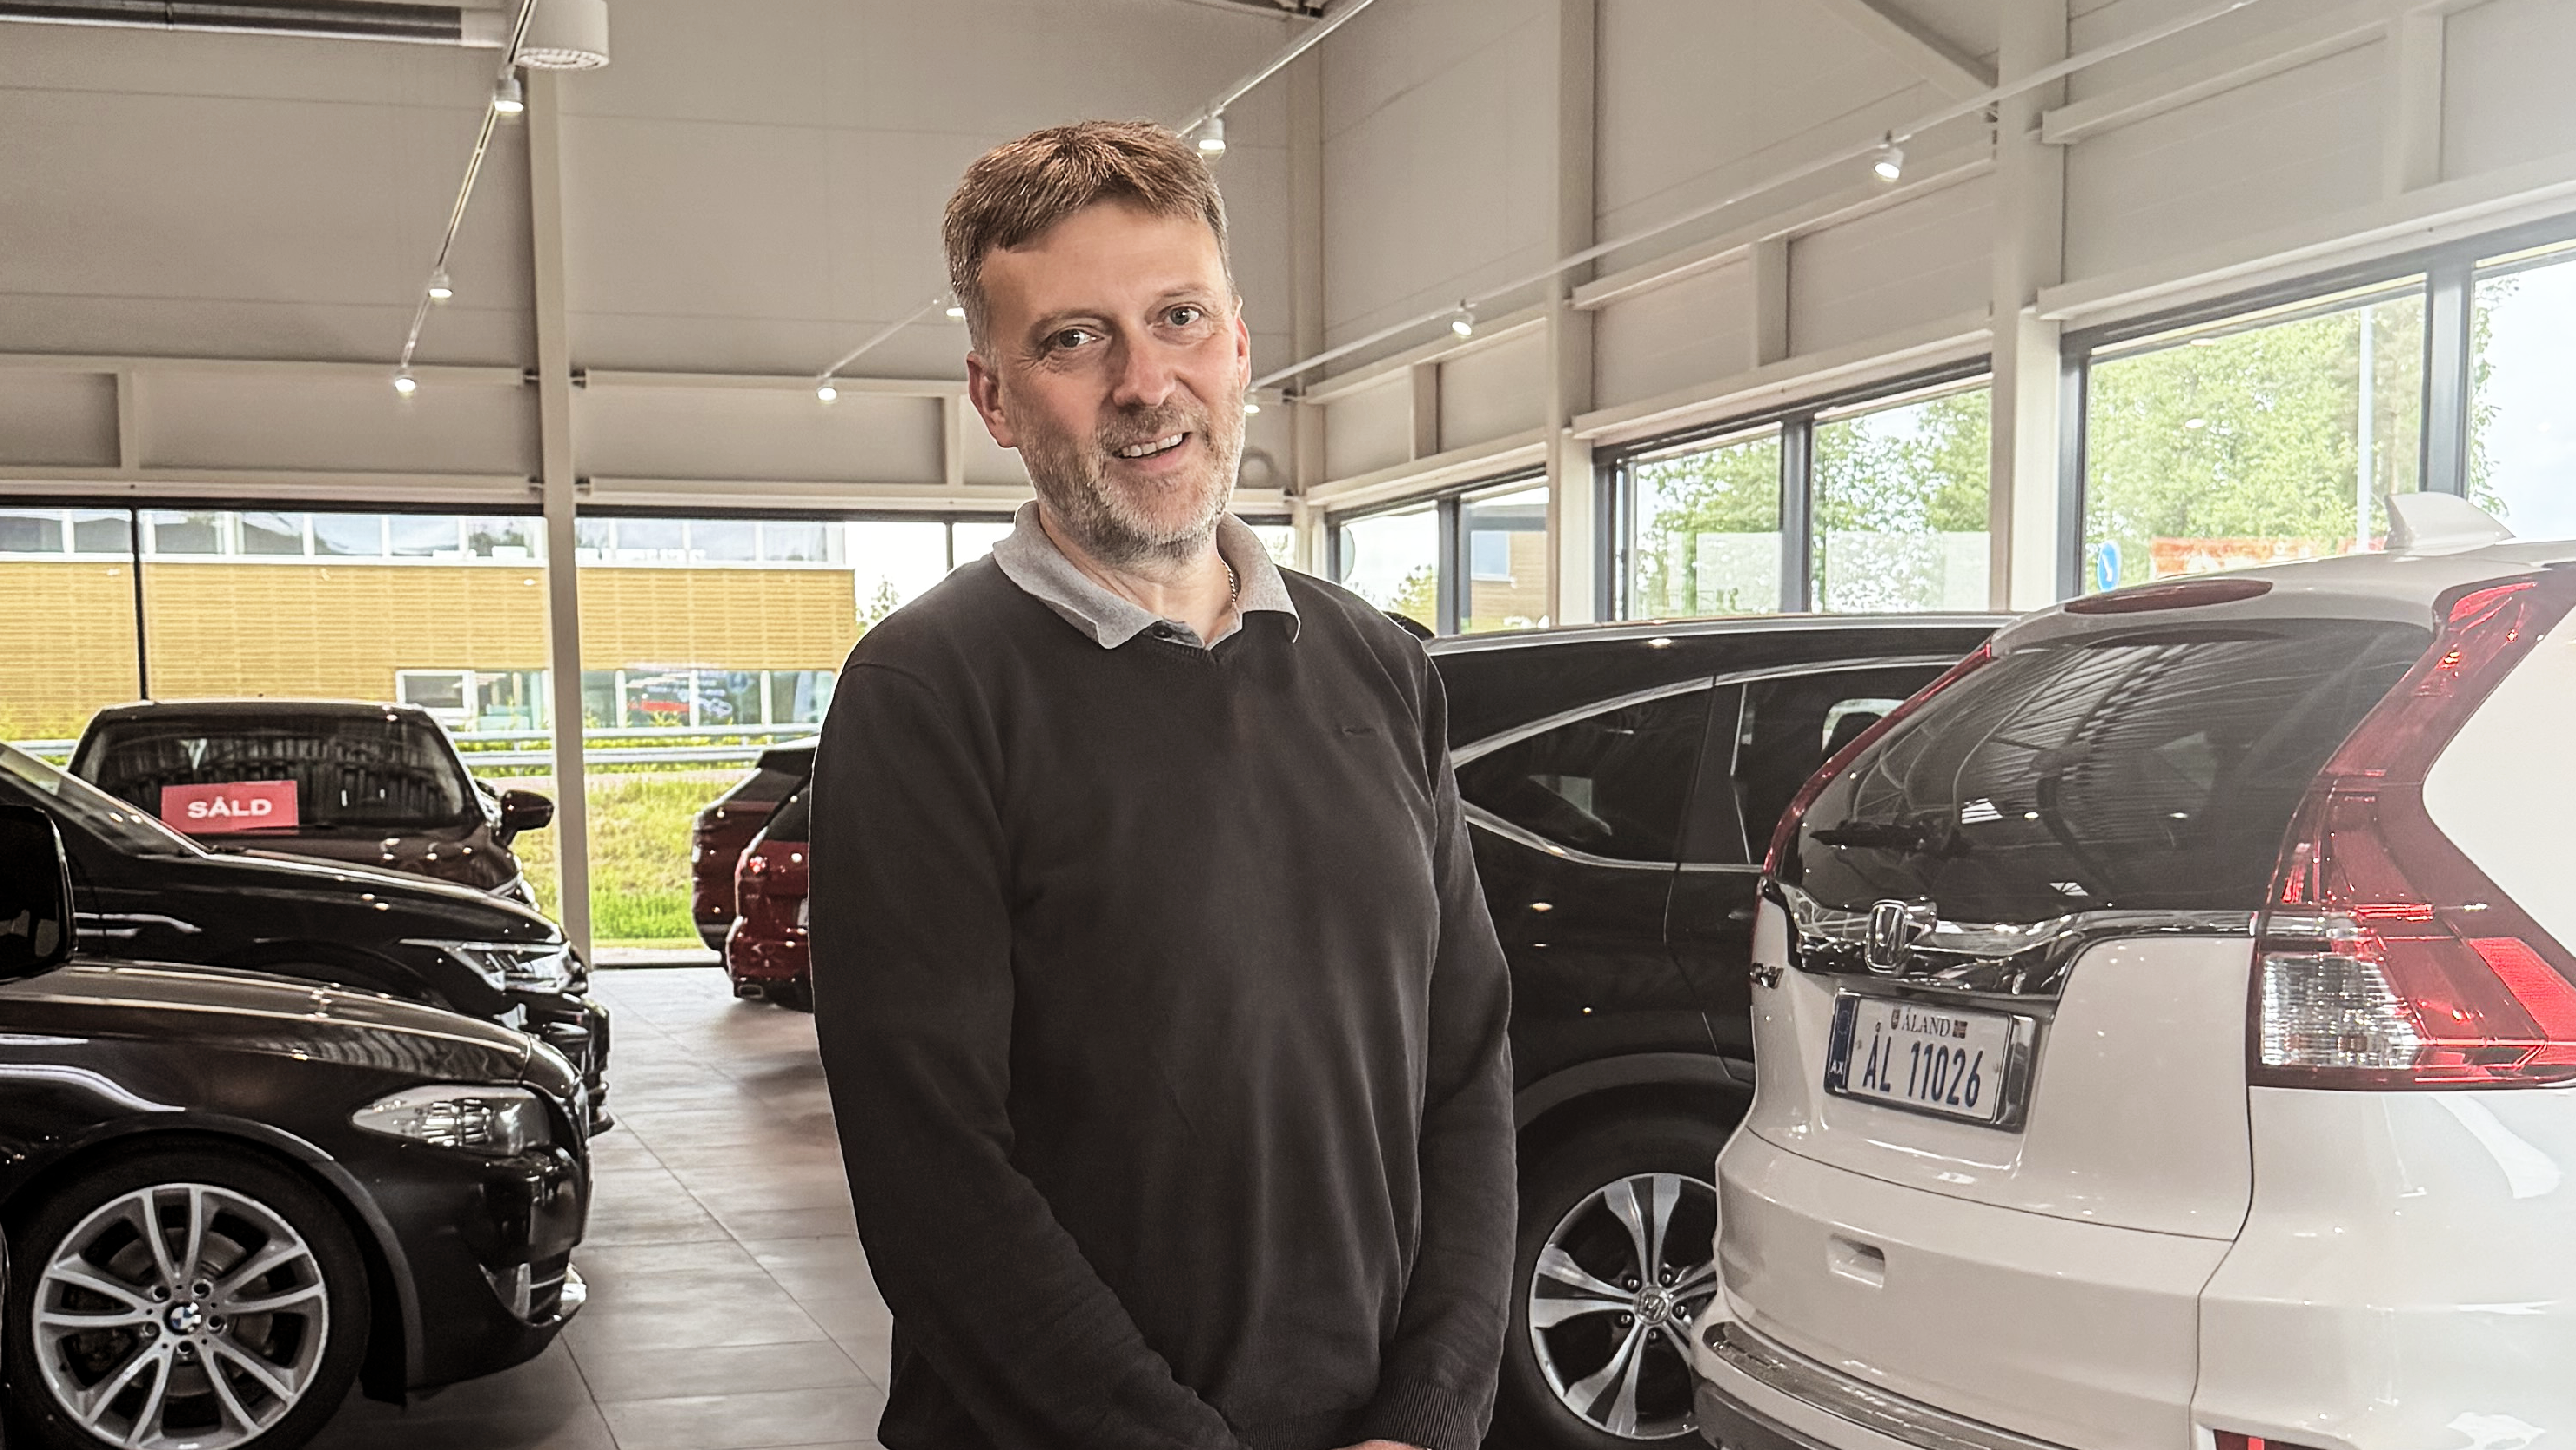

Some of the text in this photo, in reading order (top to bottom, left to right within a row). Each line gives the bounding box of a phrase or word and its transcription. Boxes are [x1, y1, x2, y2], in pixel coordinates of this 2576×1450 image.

[187, 796, 272, 818] SÅLD
[1901, 1006, 1950, 1037] ÅLAND
[1862, 1022, 1984, 1108] ÅL 11026
